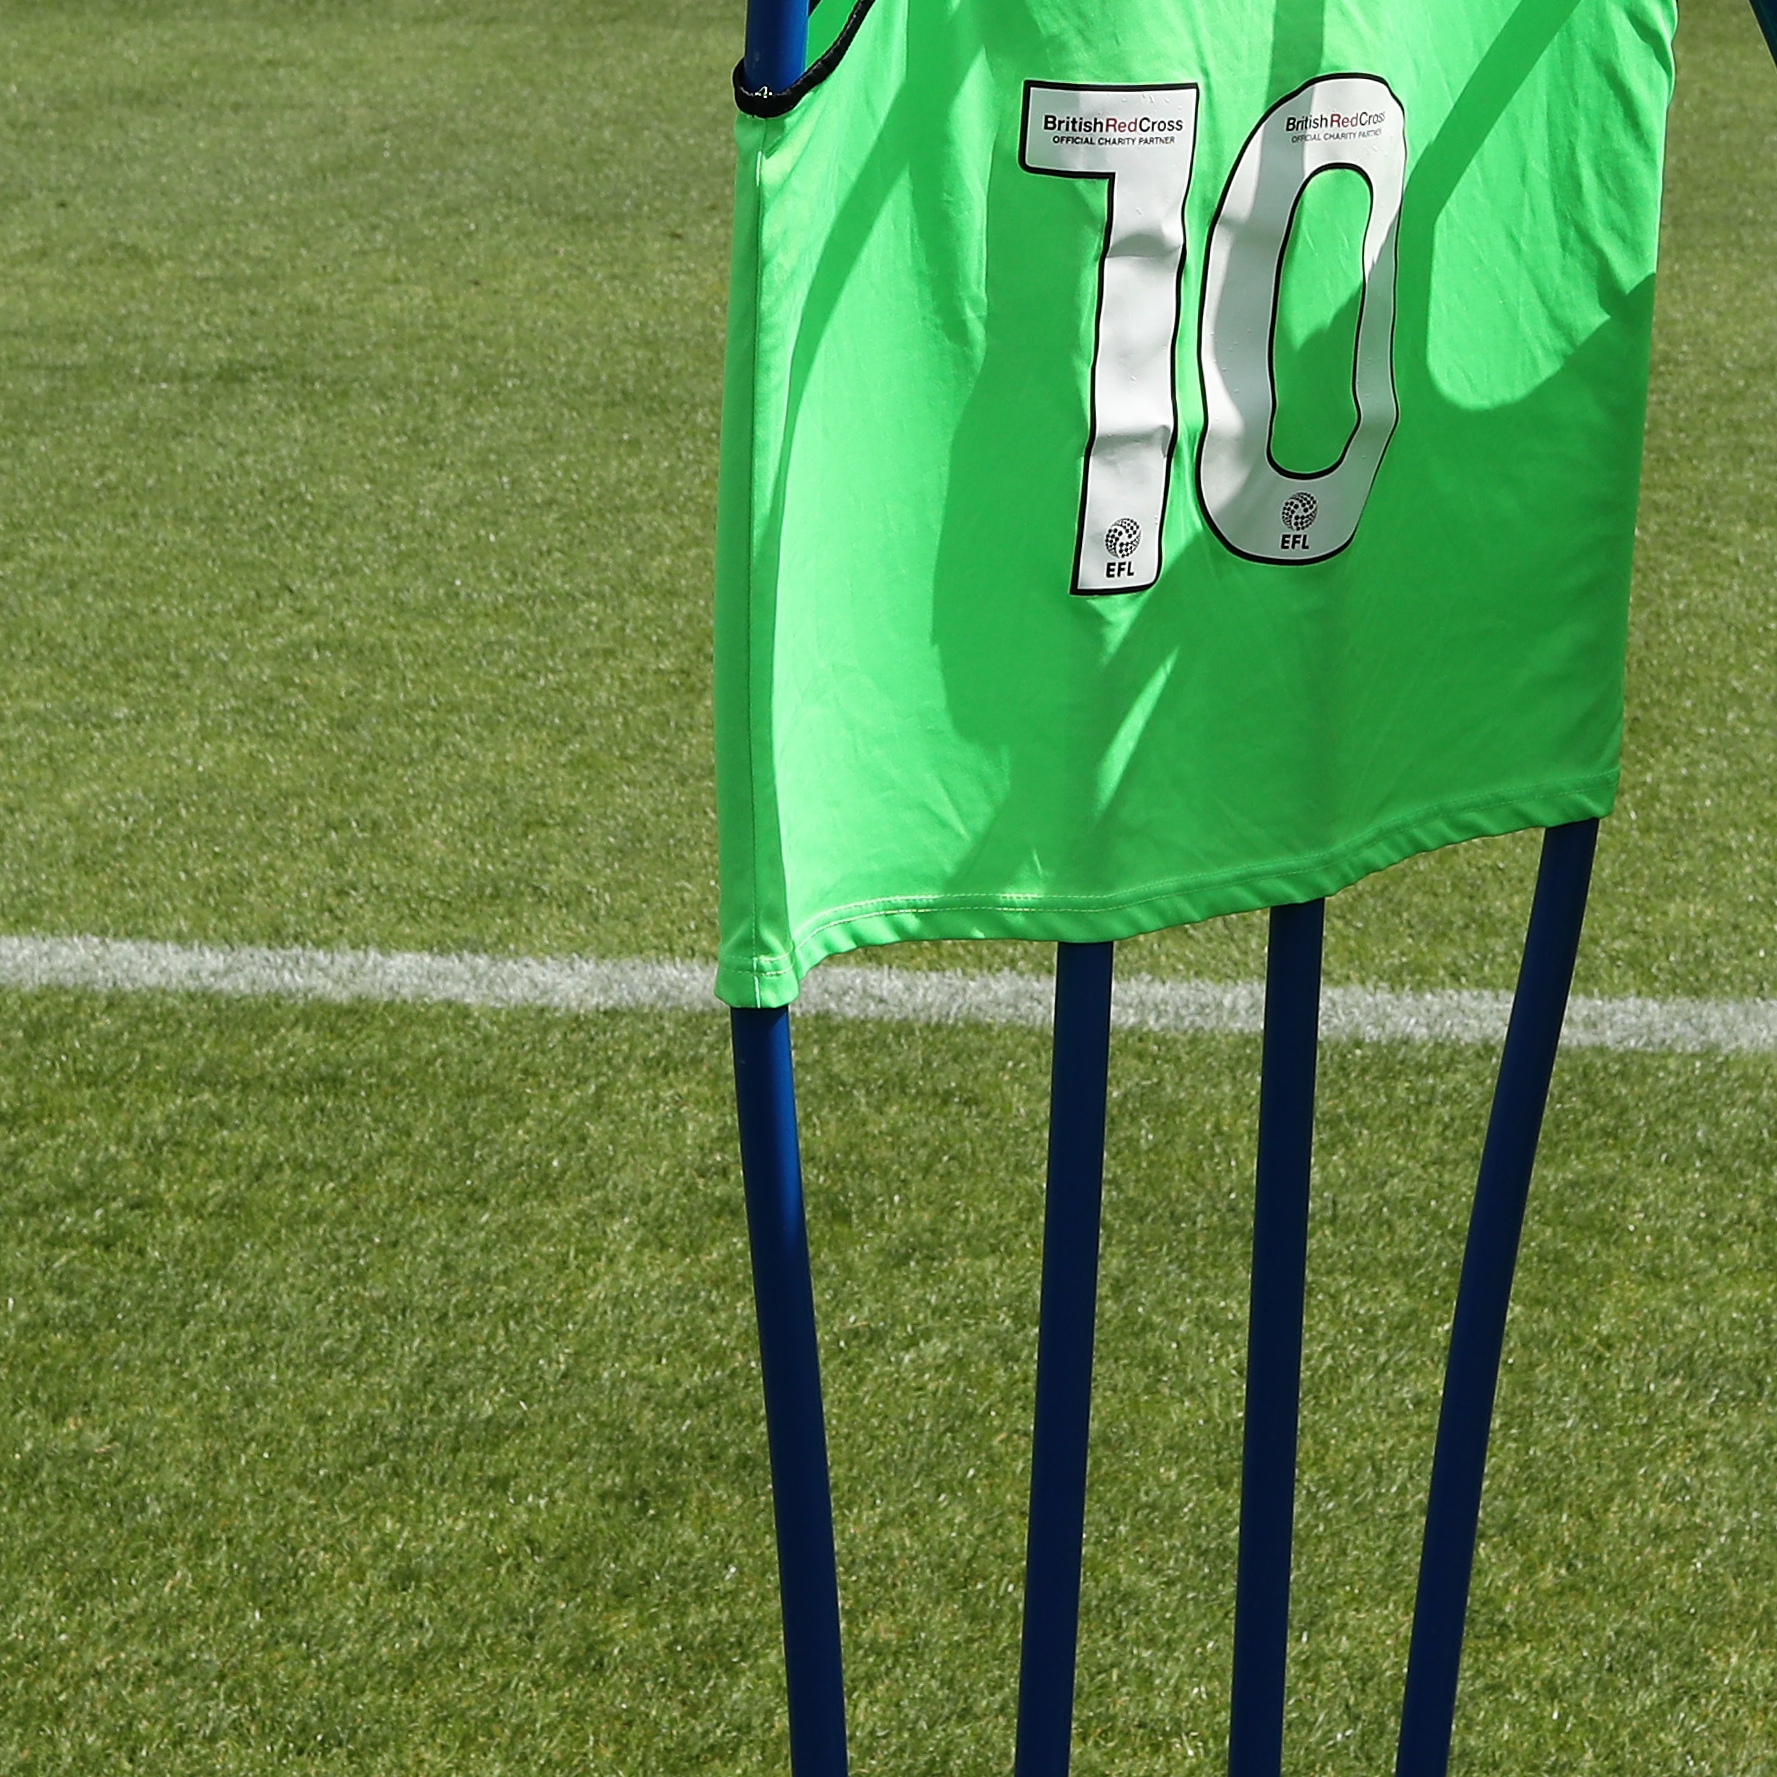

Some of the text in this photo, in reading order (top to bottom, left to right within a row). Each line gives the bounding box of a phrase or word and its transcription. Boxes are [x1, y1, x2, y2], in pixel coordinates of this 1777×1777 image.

[1052, 135, 1175, 146] OFFICIAL CHARITY PARTNER
[1323, 131, 1356, 141] CHARITY
[1018, 72, 1408, 596] 10
[1280, 534, 1310, 550] EFL
[1105, 561, 1135, 579] EFL
